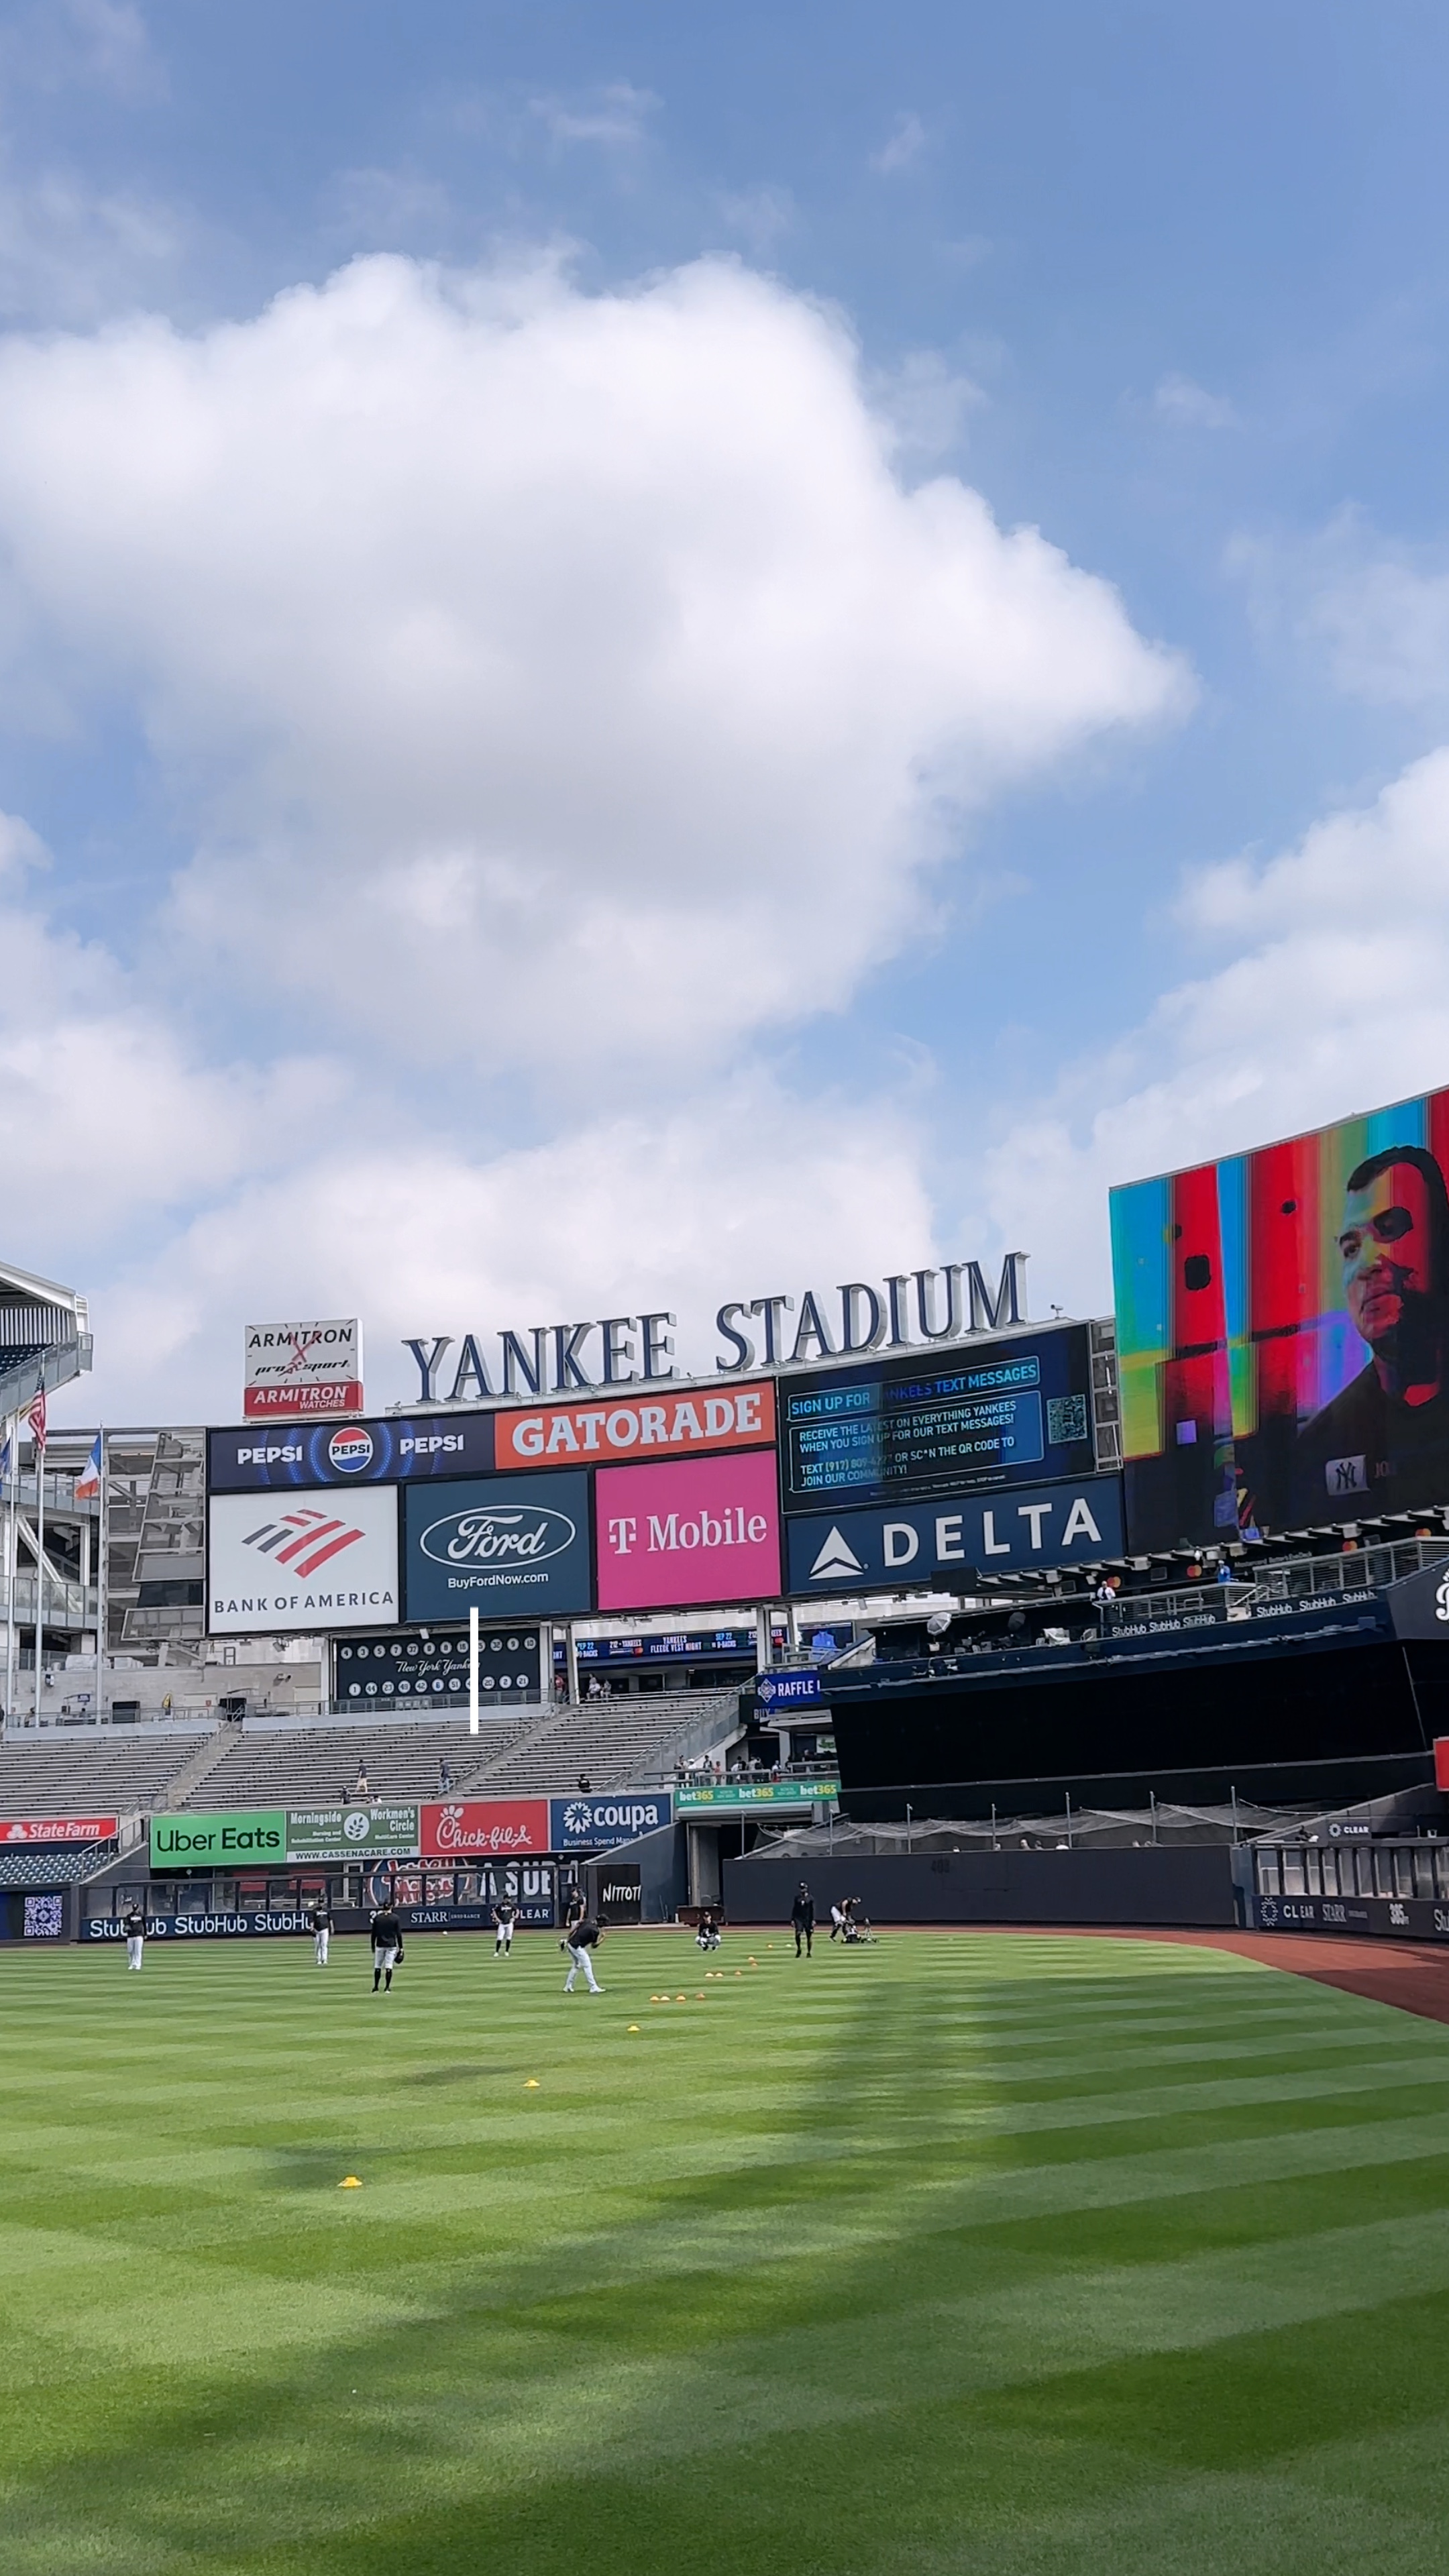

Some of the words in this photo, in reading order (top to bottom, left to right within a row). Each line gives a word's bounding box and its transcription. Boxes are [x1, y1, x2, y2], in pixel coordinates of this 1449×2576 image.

[401, 1311, 680, 1404] YANKEE
[716, 1250, 1031, 1372] STADIUM
[249, 1328, 352, 1348] ARMITRON
[254, 1386, 347, 1404] ARMITRON
[792, 1399, 821, 1415] SIGN
[824, 1397, 843, 1410] UP
[846, 1392, 870, 1407] FOR
[935, 1377, 966, 1394] TEXT
[968, 1364, 1037, 1389] MESSAGES
[299, 1399, 345, 1409] WATCHES
[512, 1393, 761, 1456] GATORADE
[800, 1428, 839, 1442] RECEIVE
[841, 1424, 859, 1436] THE
[896, 1417, 910, 1428] ON
[912, 1408, 971, 1426] EVERYTHING
[973, 1401, 1016, 1416] YANKEES
[800, 1442, 828, 1453] WHEN
[830, 1438, 850, 1449] YOU
[852, 1435, 875, 1446] SIGN
[892, 1429, 911, 1441] FOR
[913, 1426, 934, 1438] OUR
[936, 1422, 959, 1434] TEXT
[961, 1414, 1014, 1431] MESSAGES!
[237, 1446, 303, 1464] PEPSI
[332, 1445, 370, 1456] PEPSI
[400, 1434, 464, 1454] PEPSI
[800, 1463, 824, 1475] TEXT
[825, 1459, 849, 1472] (917)
[895, 1452, 908, 1462] OR
[938, 1445, 957, 1457] THE
[959, 1442, 973, 1454] QR
[974, 1439, 1000, 1451] CODE
[1001, 1436, 1014, 1448] TO
[801, 1477, 823, 1487] JOIN
[825, 1474, 846, 1484] OUR
[448, 1514, 548, 1558] Ford
[608, 1517, 637, 1555] T
[647, 1507, 767, 1553] Mobile
[883, 1497, 1102, 1568] DELTA
[448, 1572, 549, 1589] BuyFordNow.com
[214, 1598, 268, 1613] BANK
[274, 1595, 299, 1611] OF
[305, 1591, 394, 1609] AMERICA
[1256, 1603, 1293, 1618] StubHub
[1299, 1597, 1336, 1611] StubHub
[1112, 1625, 1146, 1638] StubHub
[1149, 1619, 1181, 1633] StubHub
[671, 1643, 684, 1652] VEST
[395, 1660, 418, 1672] New
[418, 1659, 442, 1676] York
[777, 1680, 814, 1697] RAFFLE
[680, 1790, 714, 1801] bet365
[739, 1787, 773, 1799] bet365
[800, 1784, 837, 1796] bet365
[290, 1813, 341, 1826] Morningside
[370, 1807, 415, 1821] Workmen's
[594, 1805, 658, 1832] coupa
[390, 1820, 415, 1832] Circle
[437, 1815, 533, 1850] Chick-fil-A
[1344, 1826, 1369, 1834] CLEAR
[157, 1830, 216, 1852] Uber
[222, 1827, 280, 1849] Eats
[564, 1839, 593, 1847] Business
[594, 1837, 614, 1847] Spend
[296, 1848, 411, 1860] WWW.CASSENACARE.COM
[411, 1912, 449, 1924] STARR
[1283, 1905, 1315, 1919] CLEAR
[90, 1919, 167, 1938] Stuub
[174, 1914, 248, 1935] StubHub
